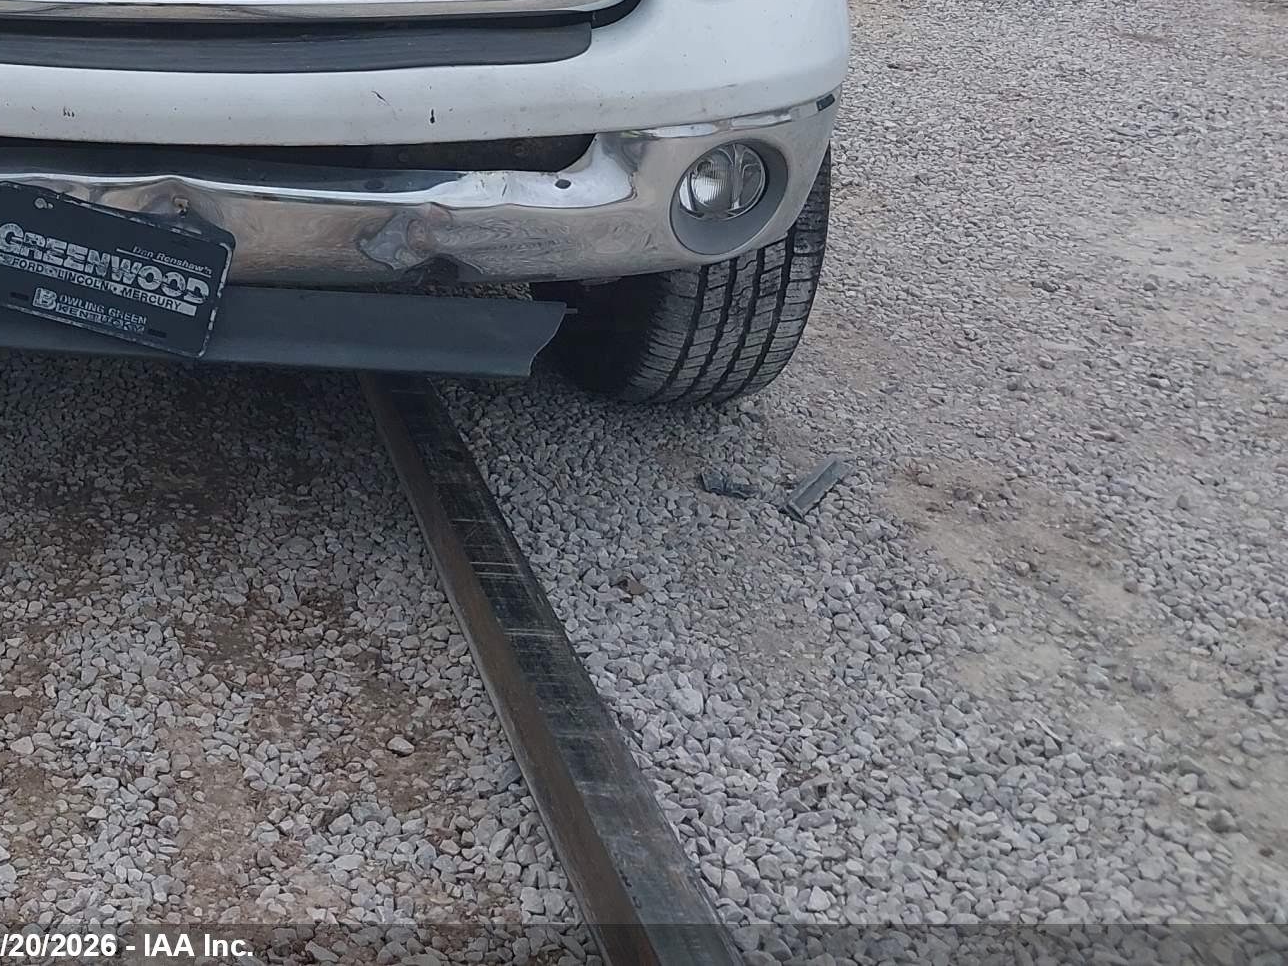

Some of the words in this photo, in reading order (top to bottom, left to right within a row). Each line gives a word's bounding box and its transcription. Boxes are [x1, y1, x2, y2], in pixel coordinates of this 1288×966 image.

[11, 257, 45, 273] FORD
[57, 268, 110, 291] LINCOLN
[122, 287, 182, 311] MERCURY
[32, 287, 106, 314] BOWLING
[108, 307, 147, 325] GREEN
